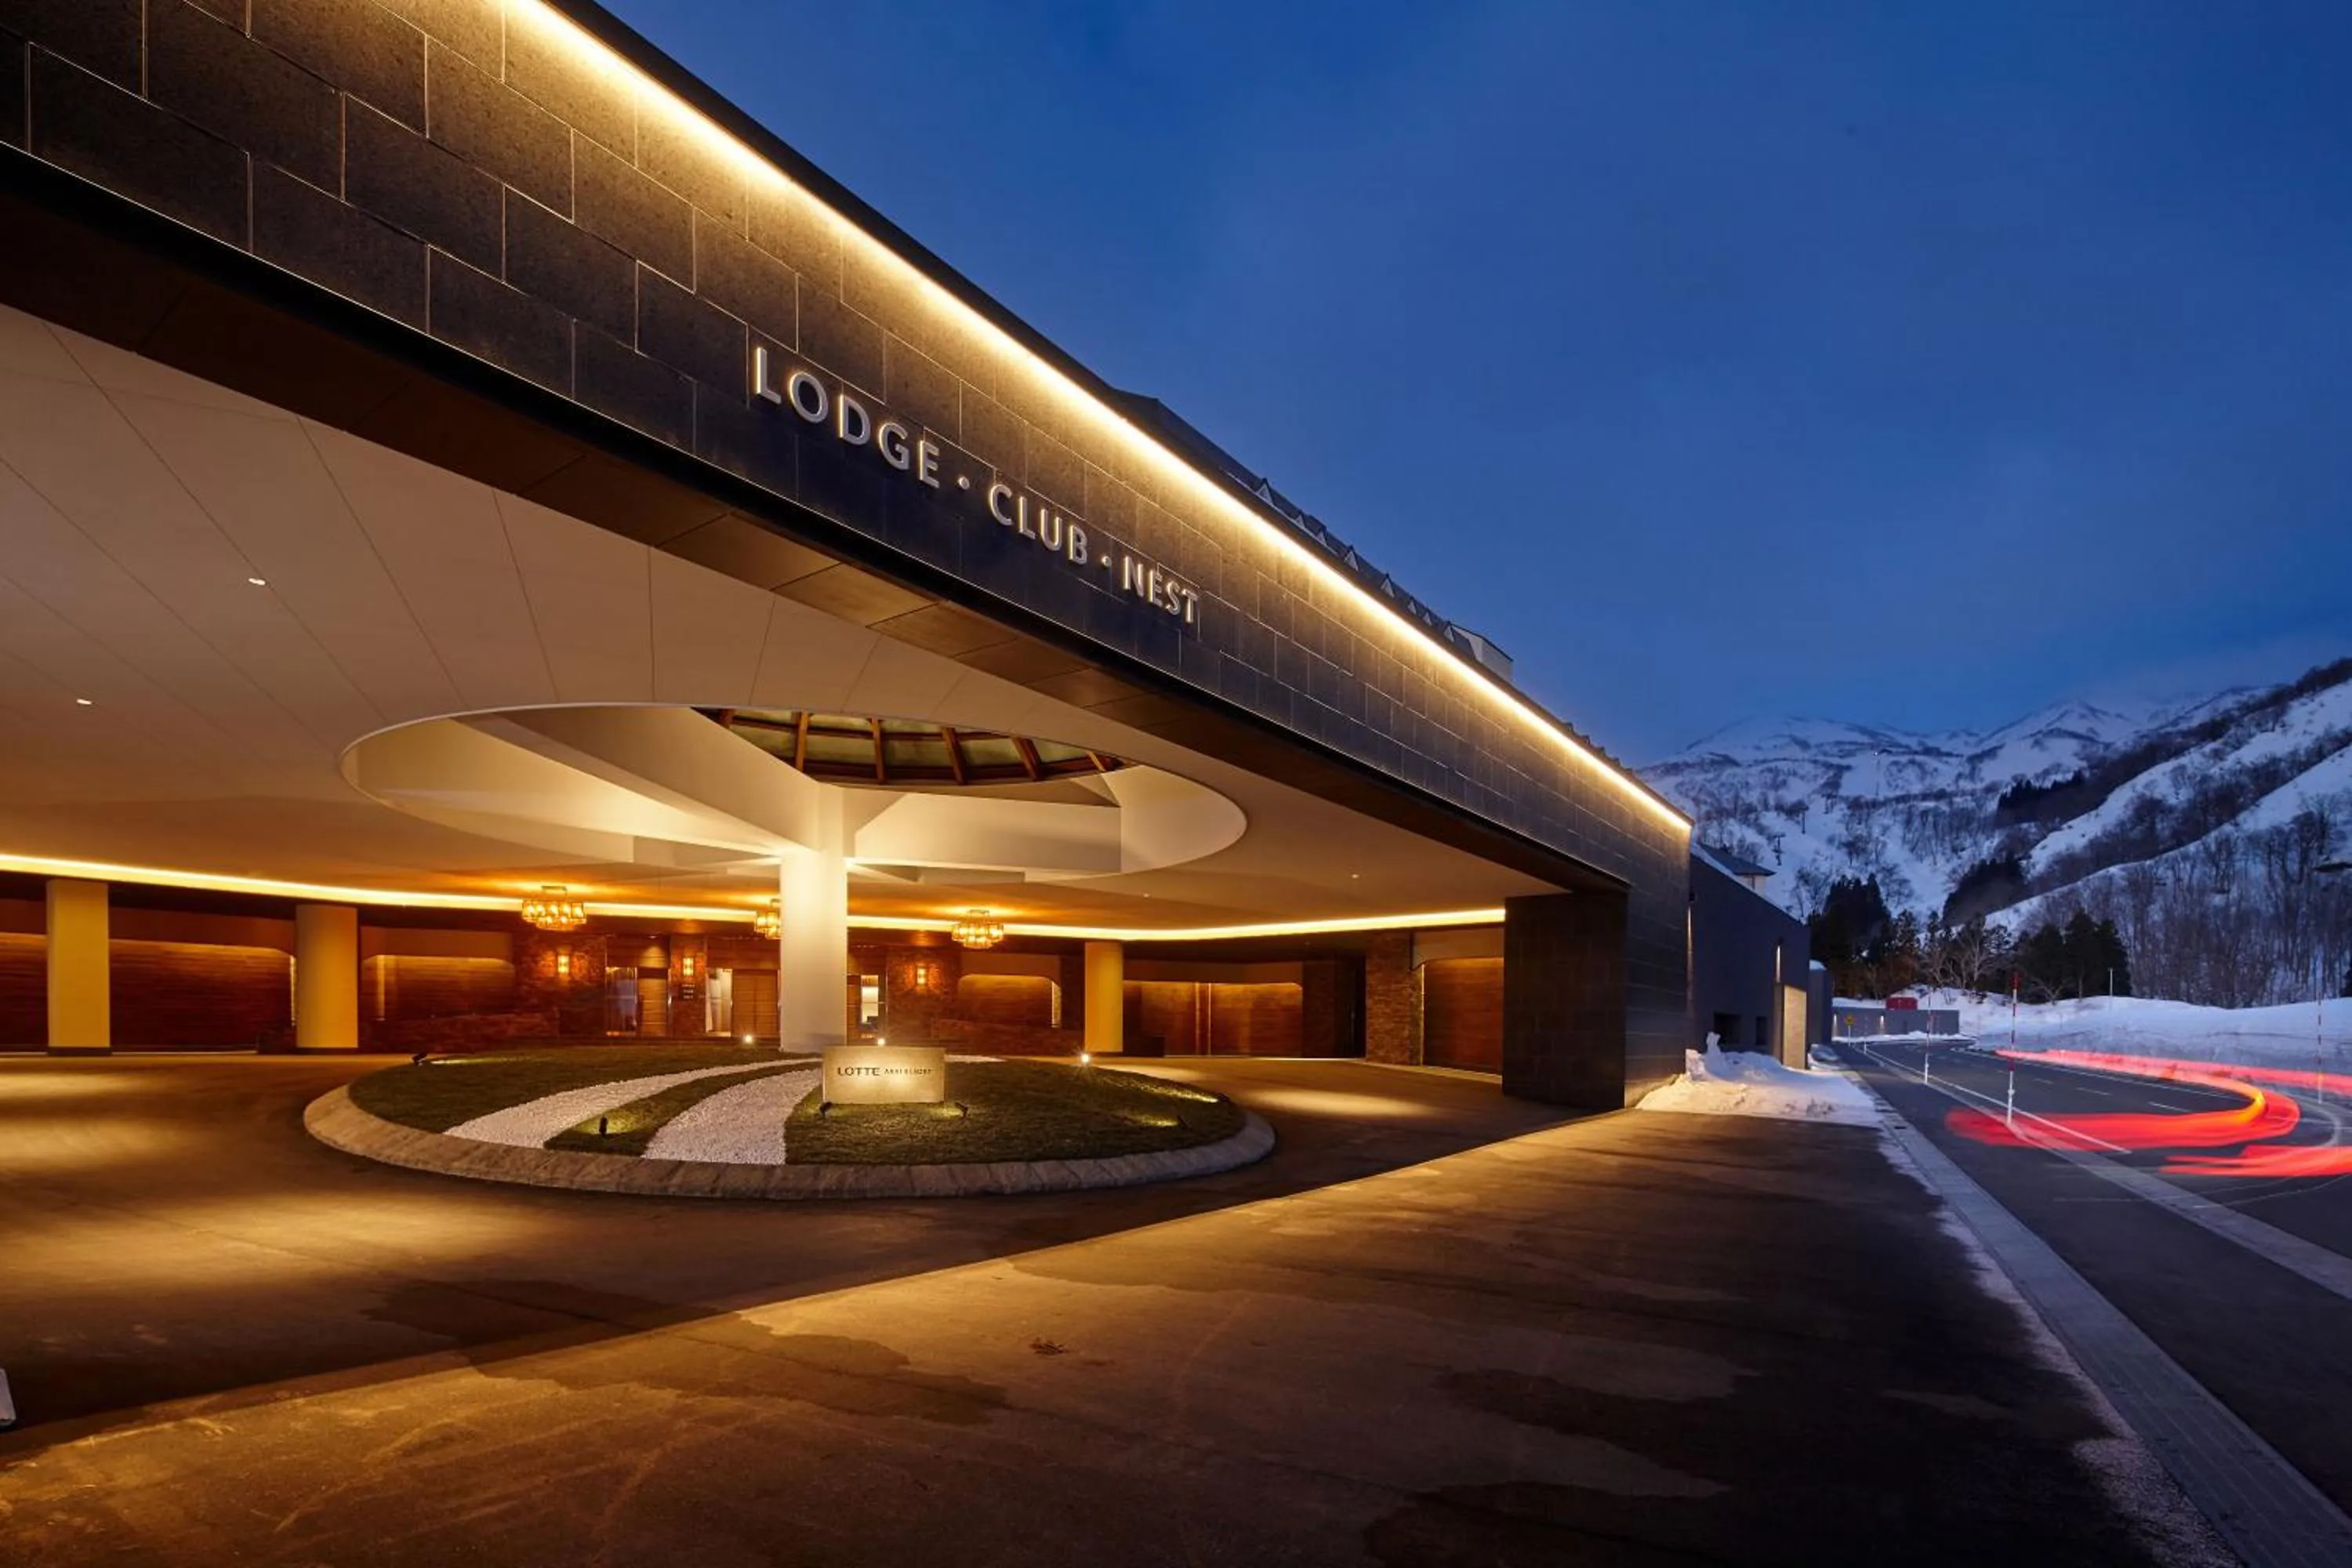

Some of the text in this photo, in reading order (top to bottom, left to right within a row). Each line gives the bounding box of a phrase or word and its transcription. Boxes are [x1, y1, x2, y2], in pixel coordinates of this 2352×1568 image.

[755, 347, 1200, 623] LODGE CLUB NEST
[837, 1066, 880, 1076] LOTTE
